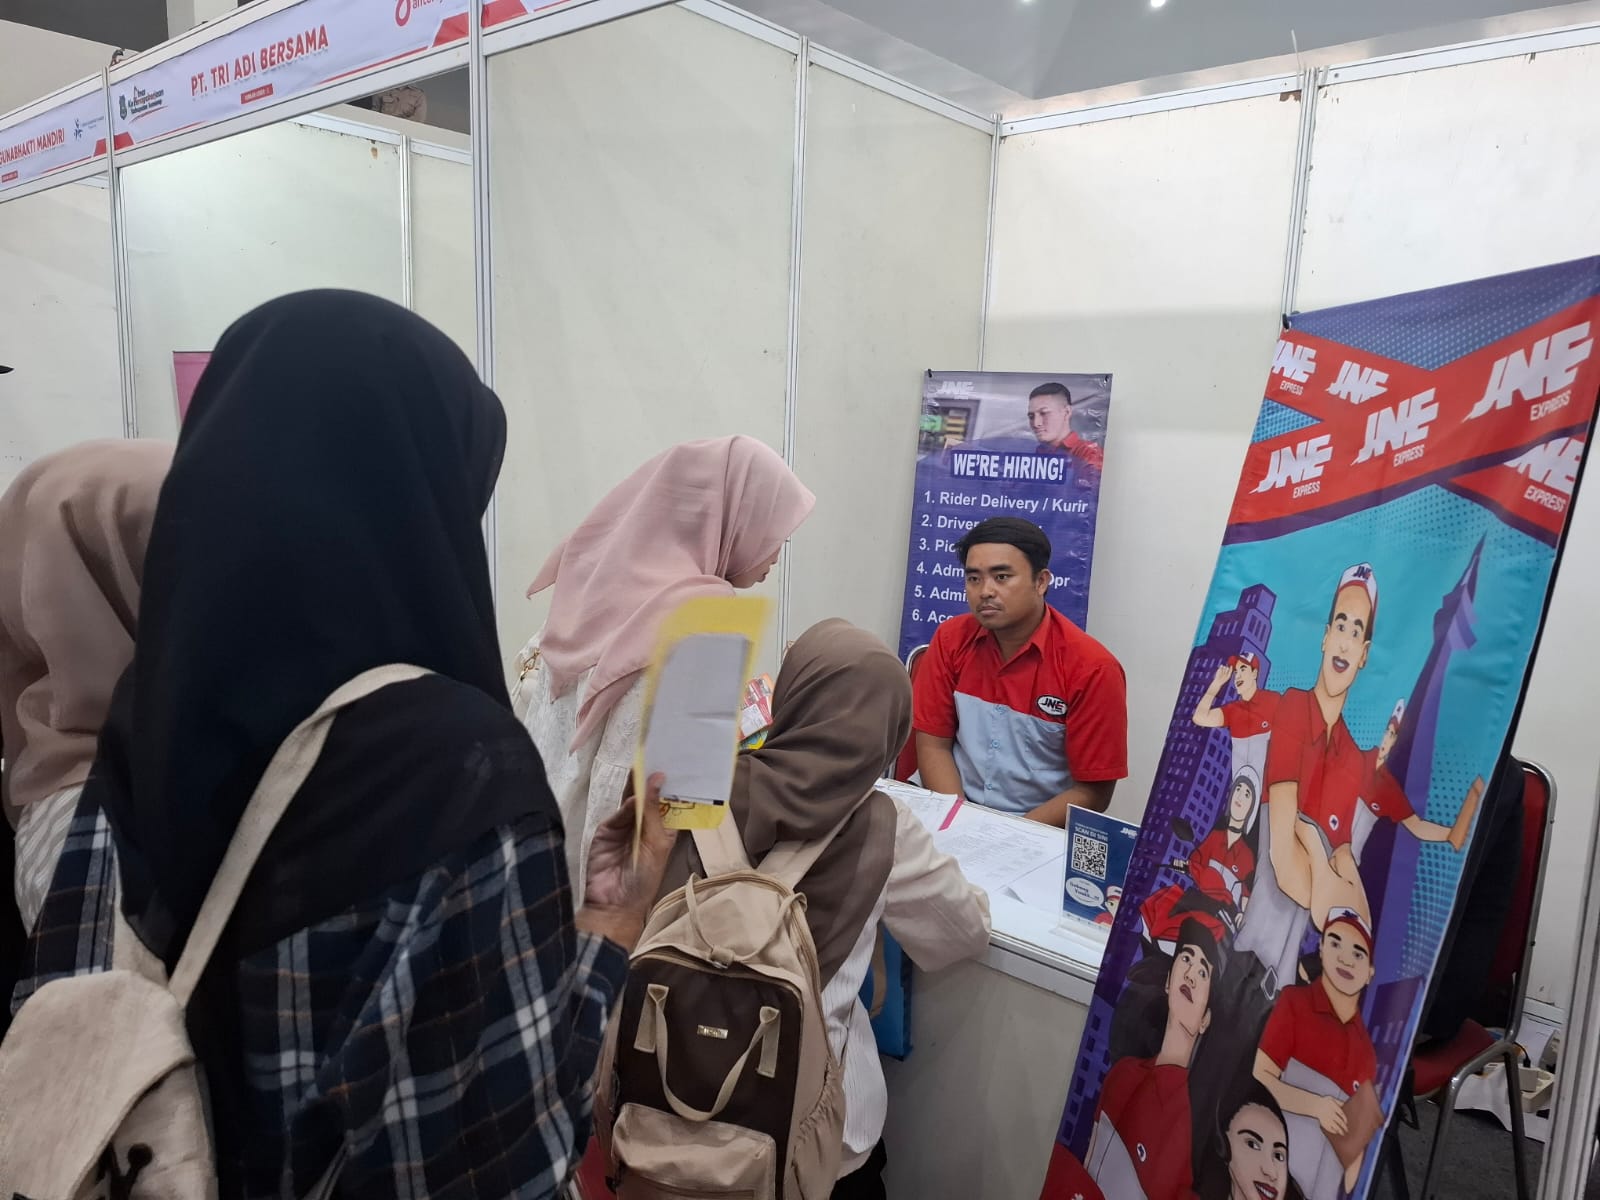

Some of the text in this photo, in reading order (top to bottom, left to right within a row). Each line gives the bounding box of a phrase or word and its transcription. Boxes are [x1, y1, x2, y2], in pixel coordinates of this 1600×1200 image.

[191, 24, 329, 97] PT. TRI ADI BERSAMA
[36, 128, 65, 150] MANDIRI
[1325, 360, 1390, 405] JNE
[1461, 321, 1594, 423] JNE
[1279, 380, 1304, 396] EXPRESS
[1530, 390, 1572, 422] EXPRESS
[1351, 388, 1439, 466] JNE
[953, 453, 1065, 481] WE'RE HIRING!
[1249, 434, 1333, 494] JNE
[1393, 444, 1425, 468] EXPRESS
[1292, 481, 1321, 499] EXPRESS
[1523, 485, 1566, 512] EXPRESS
[924, 491, 1088, 513] 1. Rider Delivery / Kurir
[921, 514, 979, 530] 2. Driver
[919, 537, 956, 552] 3. Pic
[916, 561, 964, 577] 4. Adm
[914, 585, 968, 602] 5. Admi
[912, 608, 954, 623] 6. Acc
[1039, 697, 1065, 711] JNE
